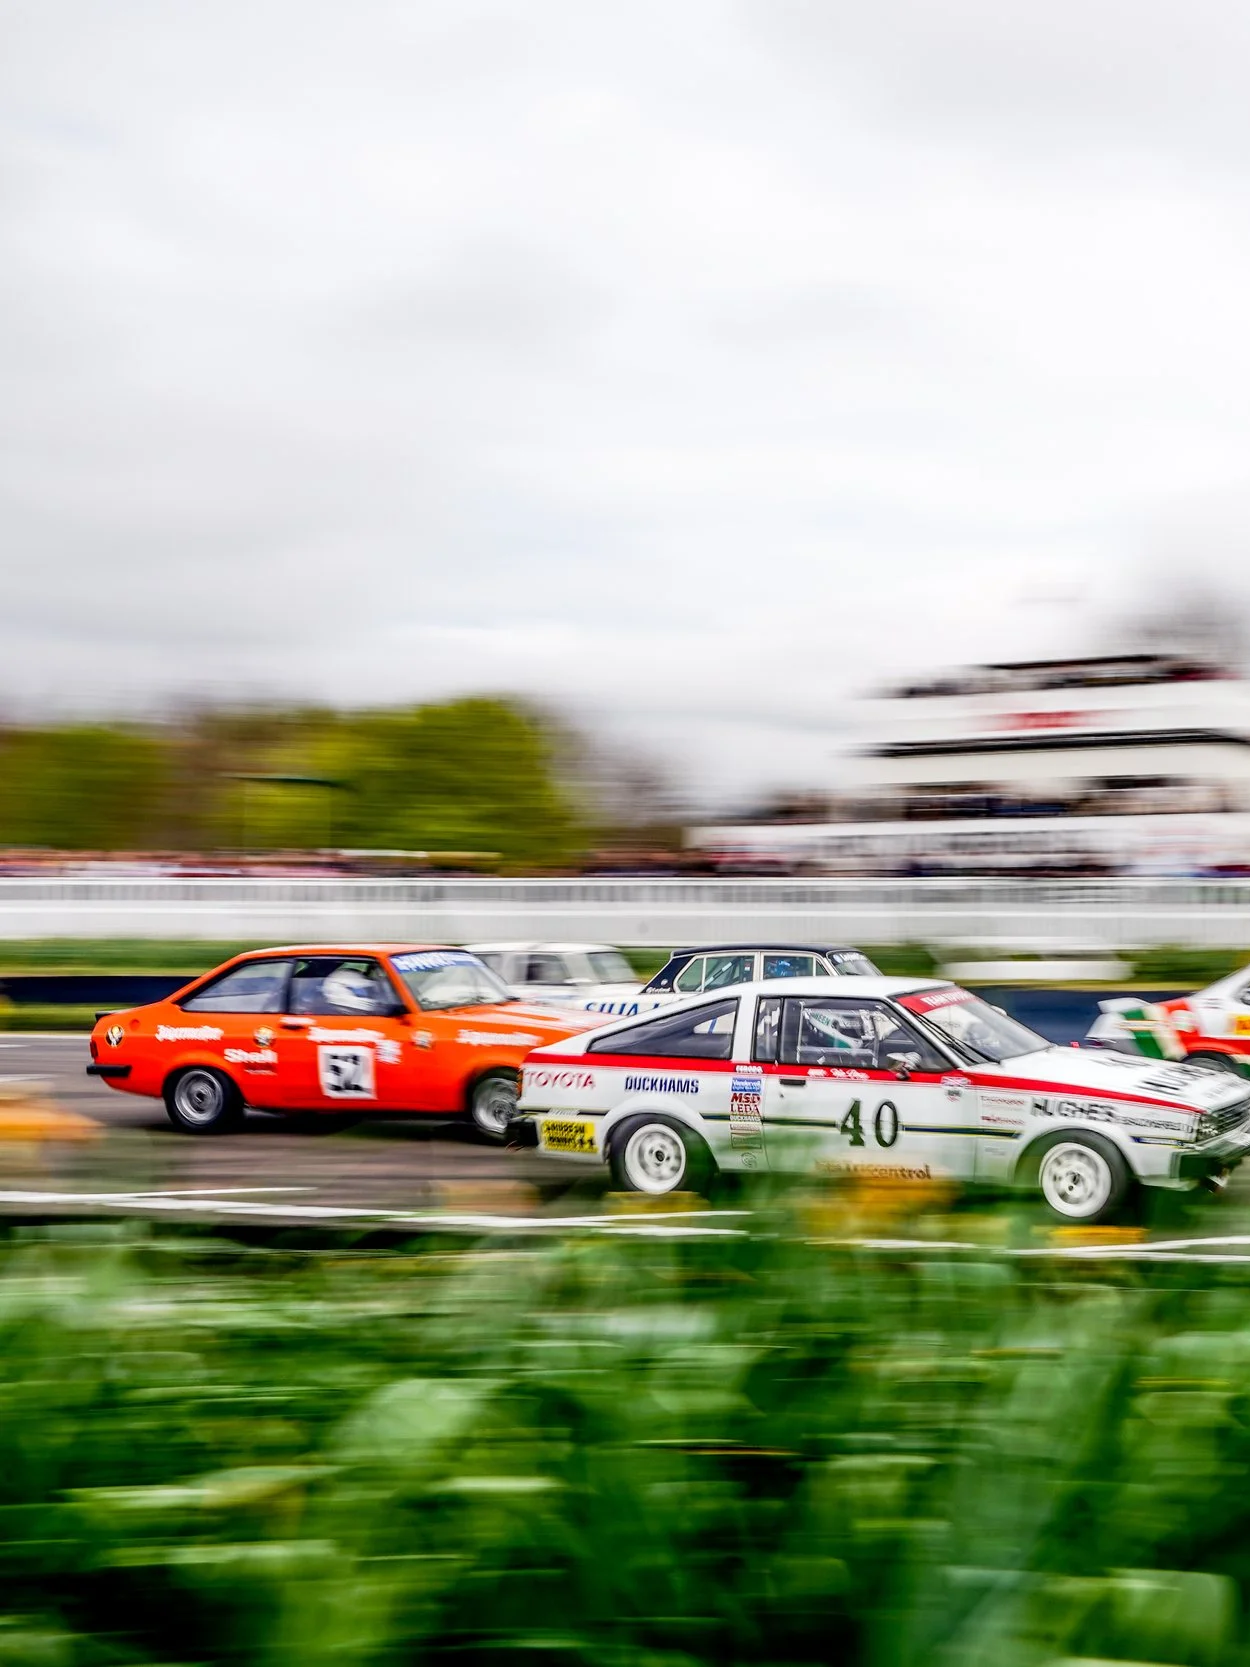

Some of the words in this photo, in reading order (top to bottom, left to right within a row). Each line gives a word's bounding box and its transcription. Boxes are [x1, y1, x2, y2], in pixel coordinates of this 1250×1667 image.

[524, 1070, 597, 1091] TOYOTA
[624, 1075, 700, 1094] DUCKHAMS
[840, 1098, 899, 1148] 40
